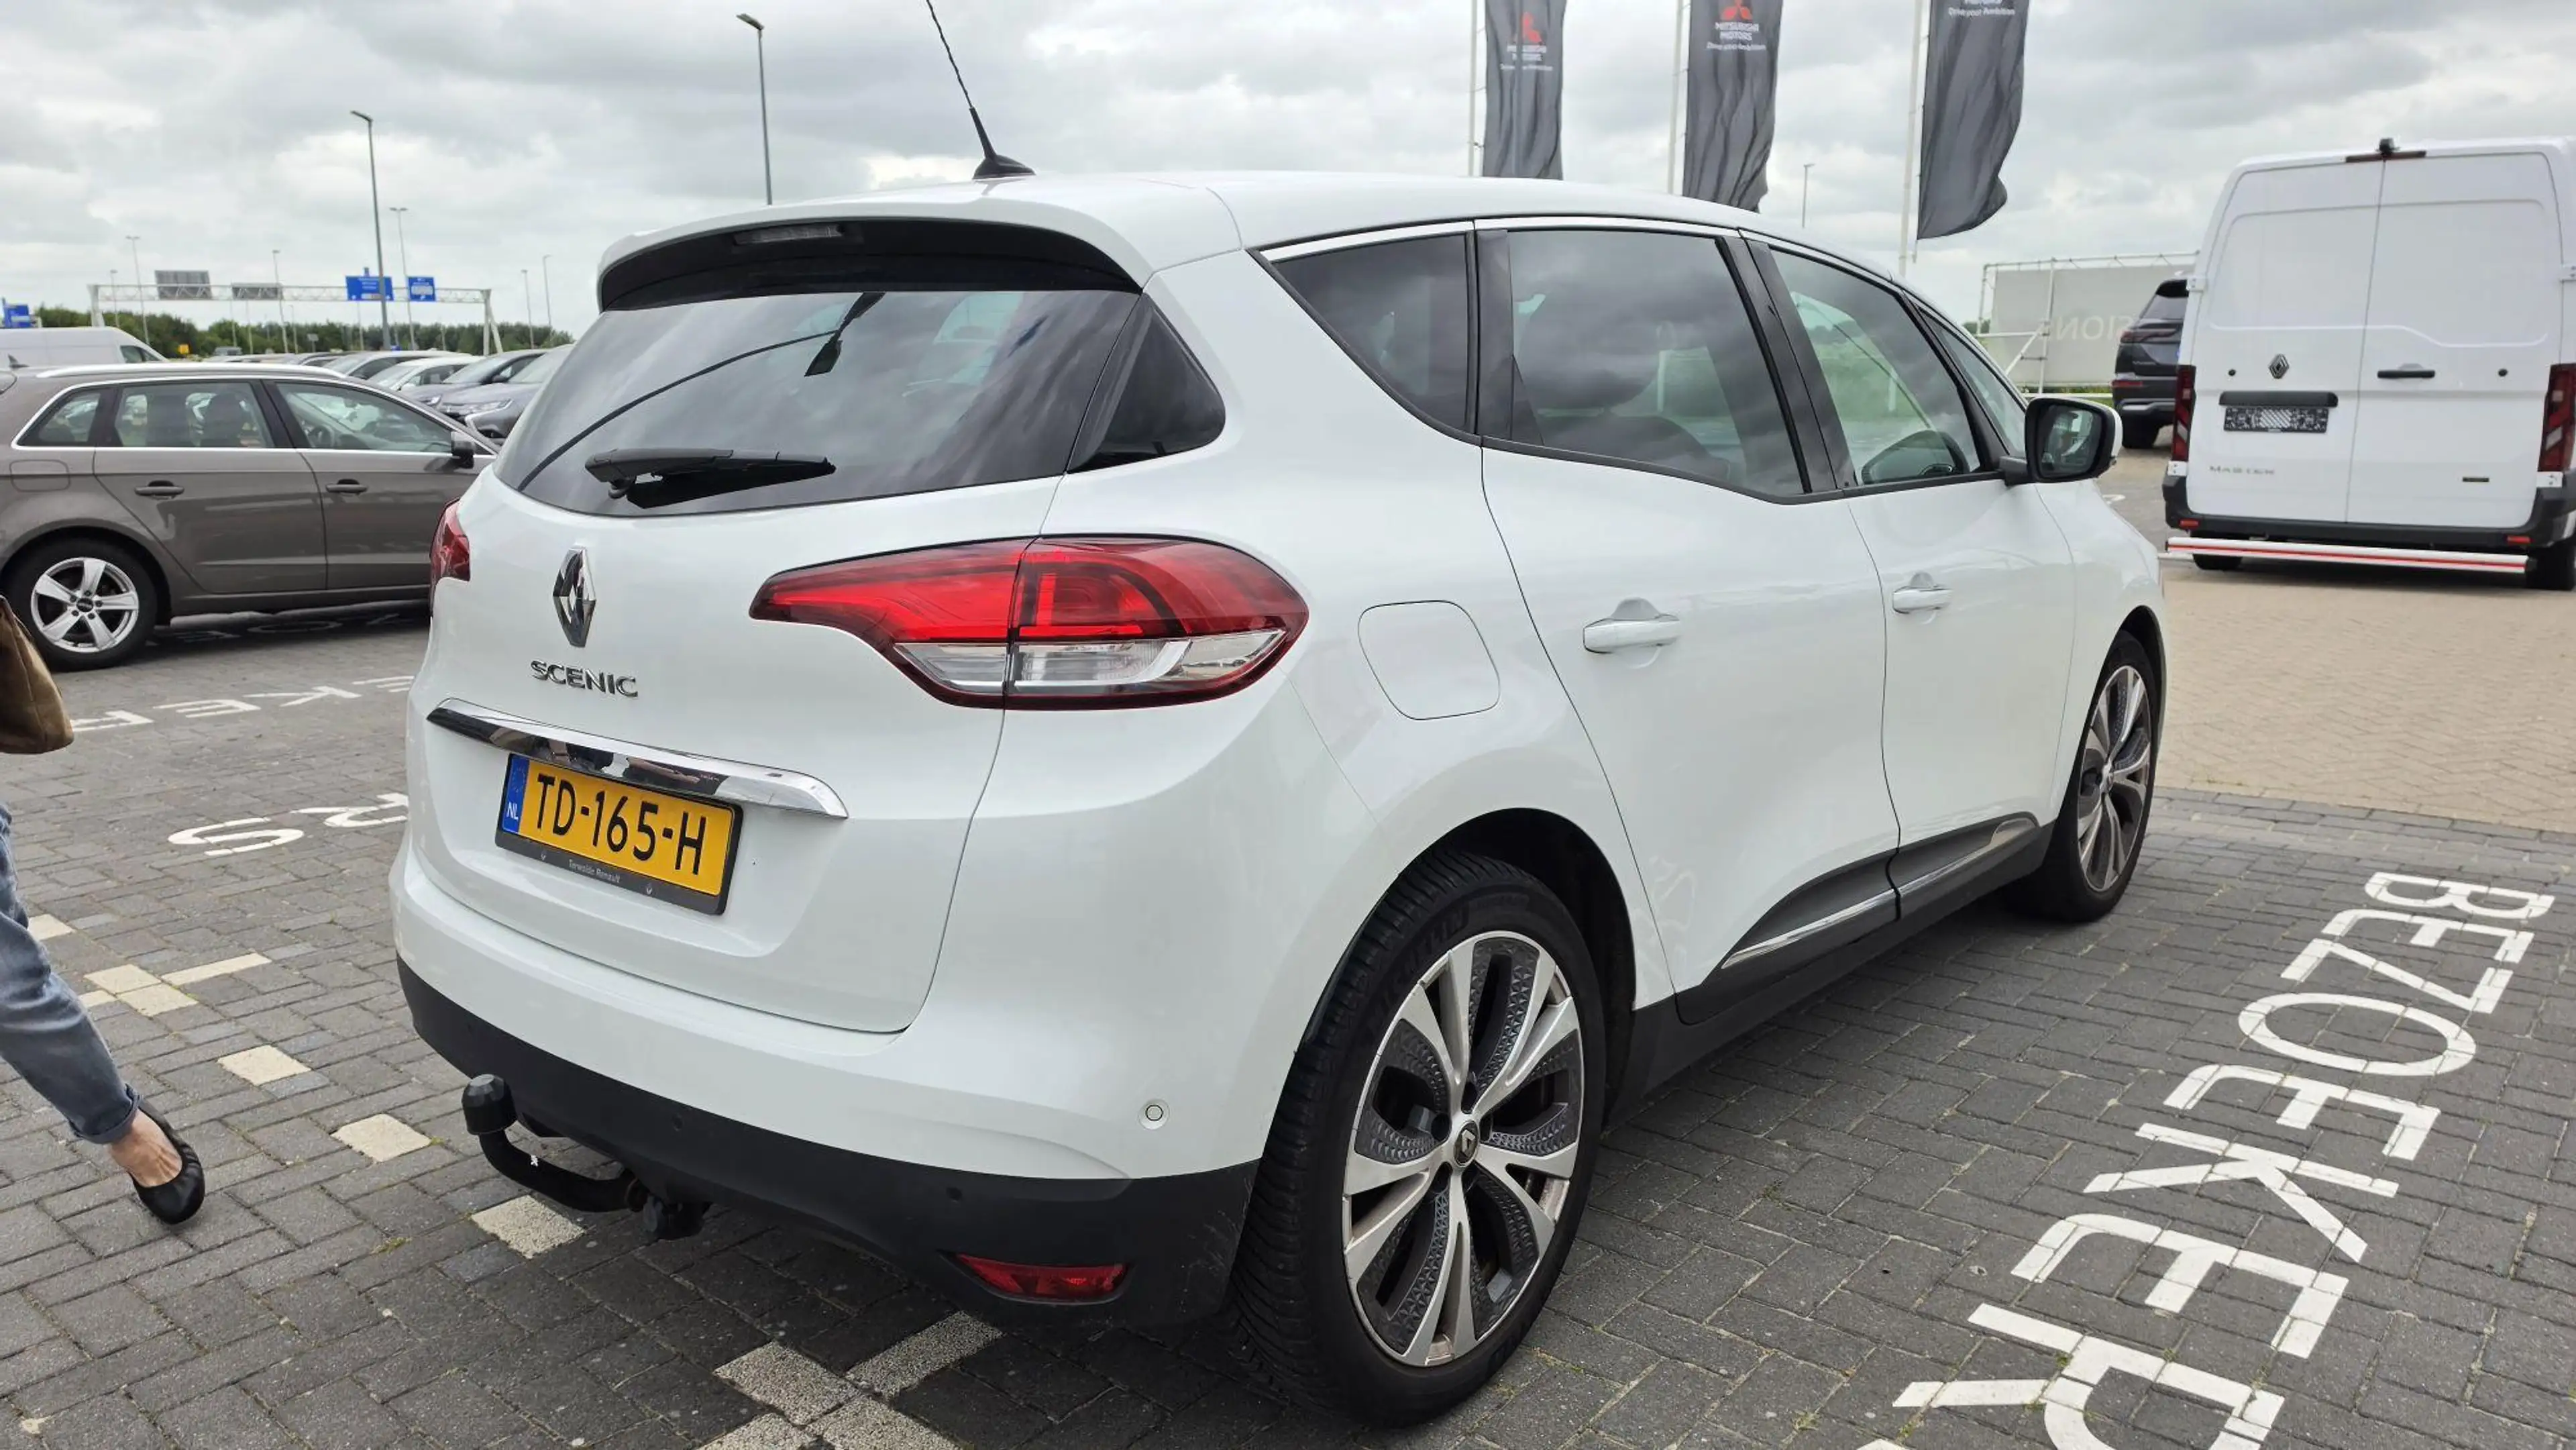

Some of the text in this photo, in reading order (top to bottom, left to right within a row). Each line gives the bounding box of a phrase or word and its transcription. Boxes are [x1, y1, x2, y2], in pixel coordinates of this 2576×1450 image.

[531, 660, 638, 697] SCENIC
[506, 802, 519, 820] NL
[537, 773, 706, 875] TD-165-H
[1857, 872, 2555, 1450] BEZOEKER
